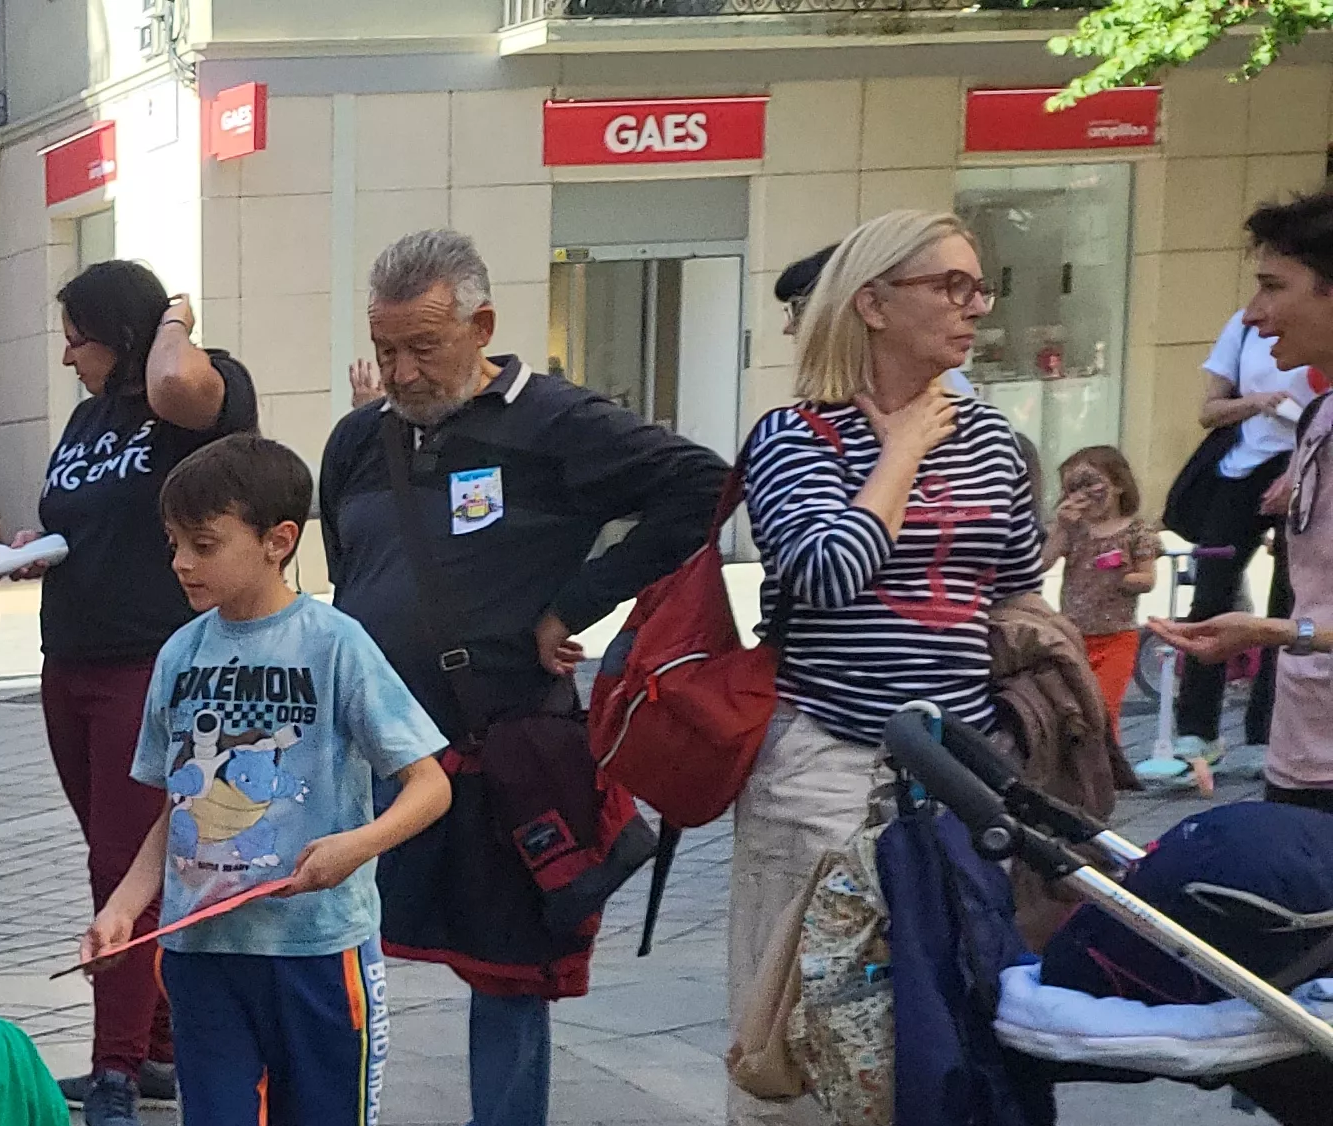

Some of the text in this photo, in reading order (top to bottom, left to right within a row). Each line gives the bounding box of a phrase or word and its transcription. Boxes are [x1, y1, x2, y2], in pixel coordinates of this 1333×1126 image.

[603, 112, 708, 154] GAES
[169, 655, 318, 708] PKÉMON
[366, 960, 390, 1057] BOARD
